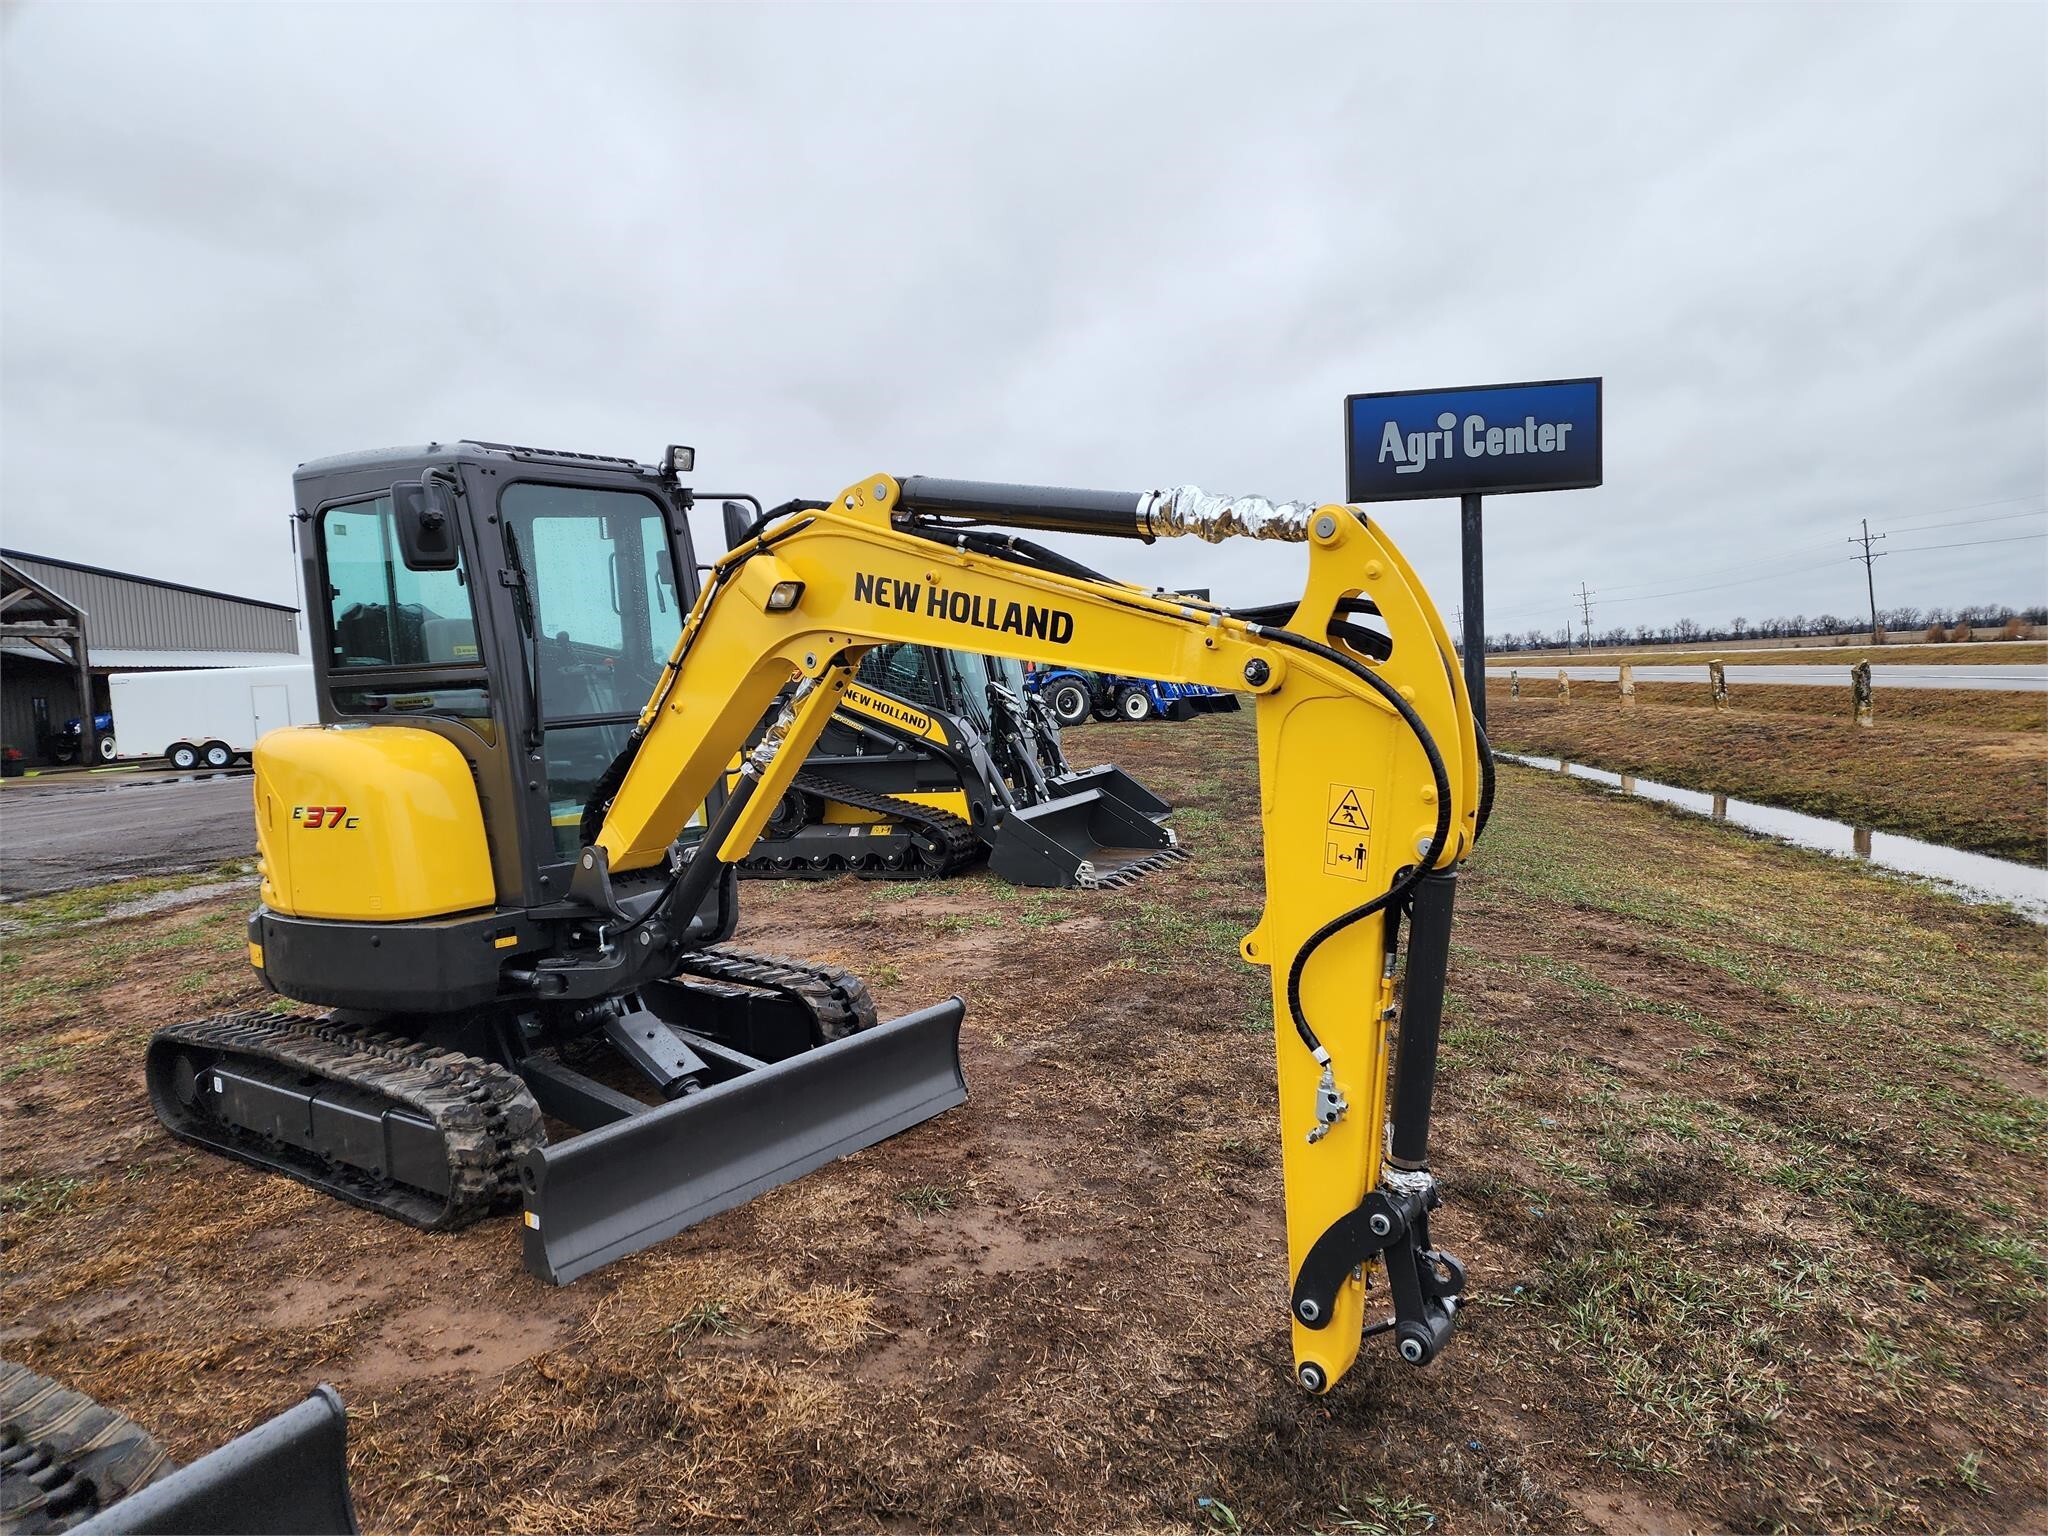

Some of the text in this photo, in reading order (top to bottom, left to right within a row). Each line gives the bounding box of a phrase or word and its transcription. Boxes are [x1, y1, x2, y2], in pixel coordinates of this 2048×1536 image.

[1378, 412, 1572, 474] Agri Center
[854, 572, 1074, 644] NEW HOLLAND
[843, 689, 871, 706] NEW
[872, 699, 926, 729] HOLLAND
